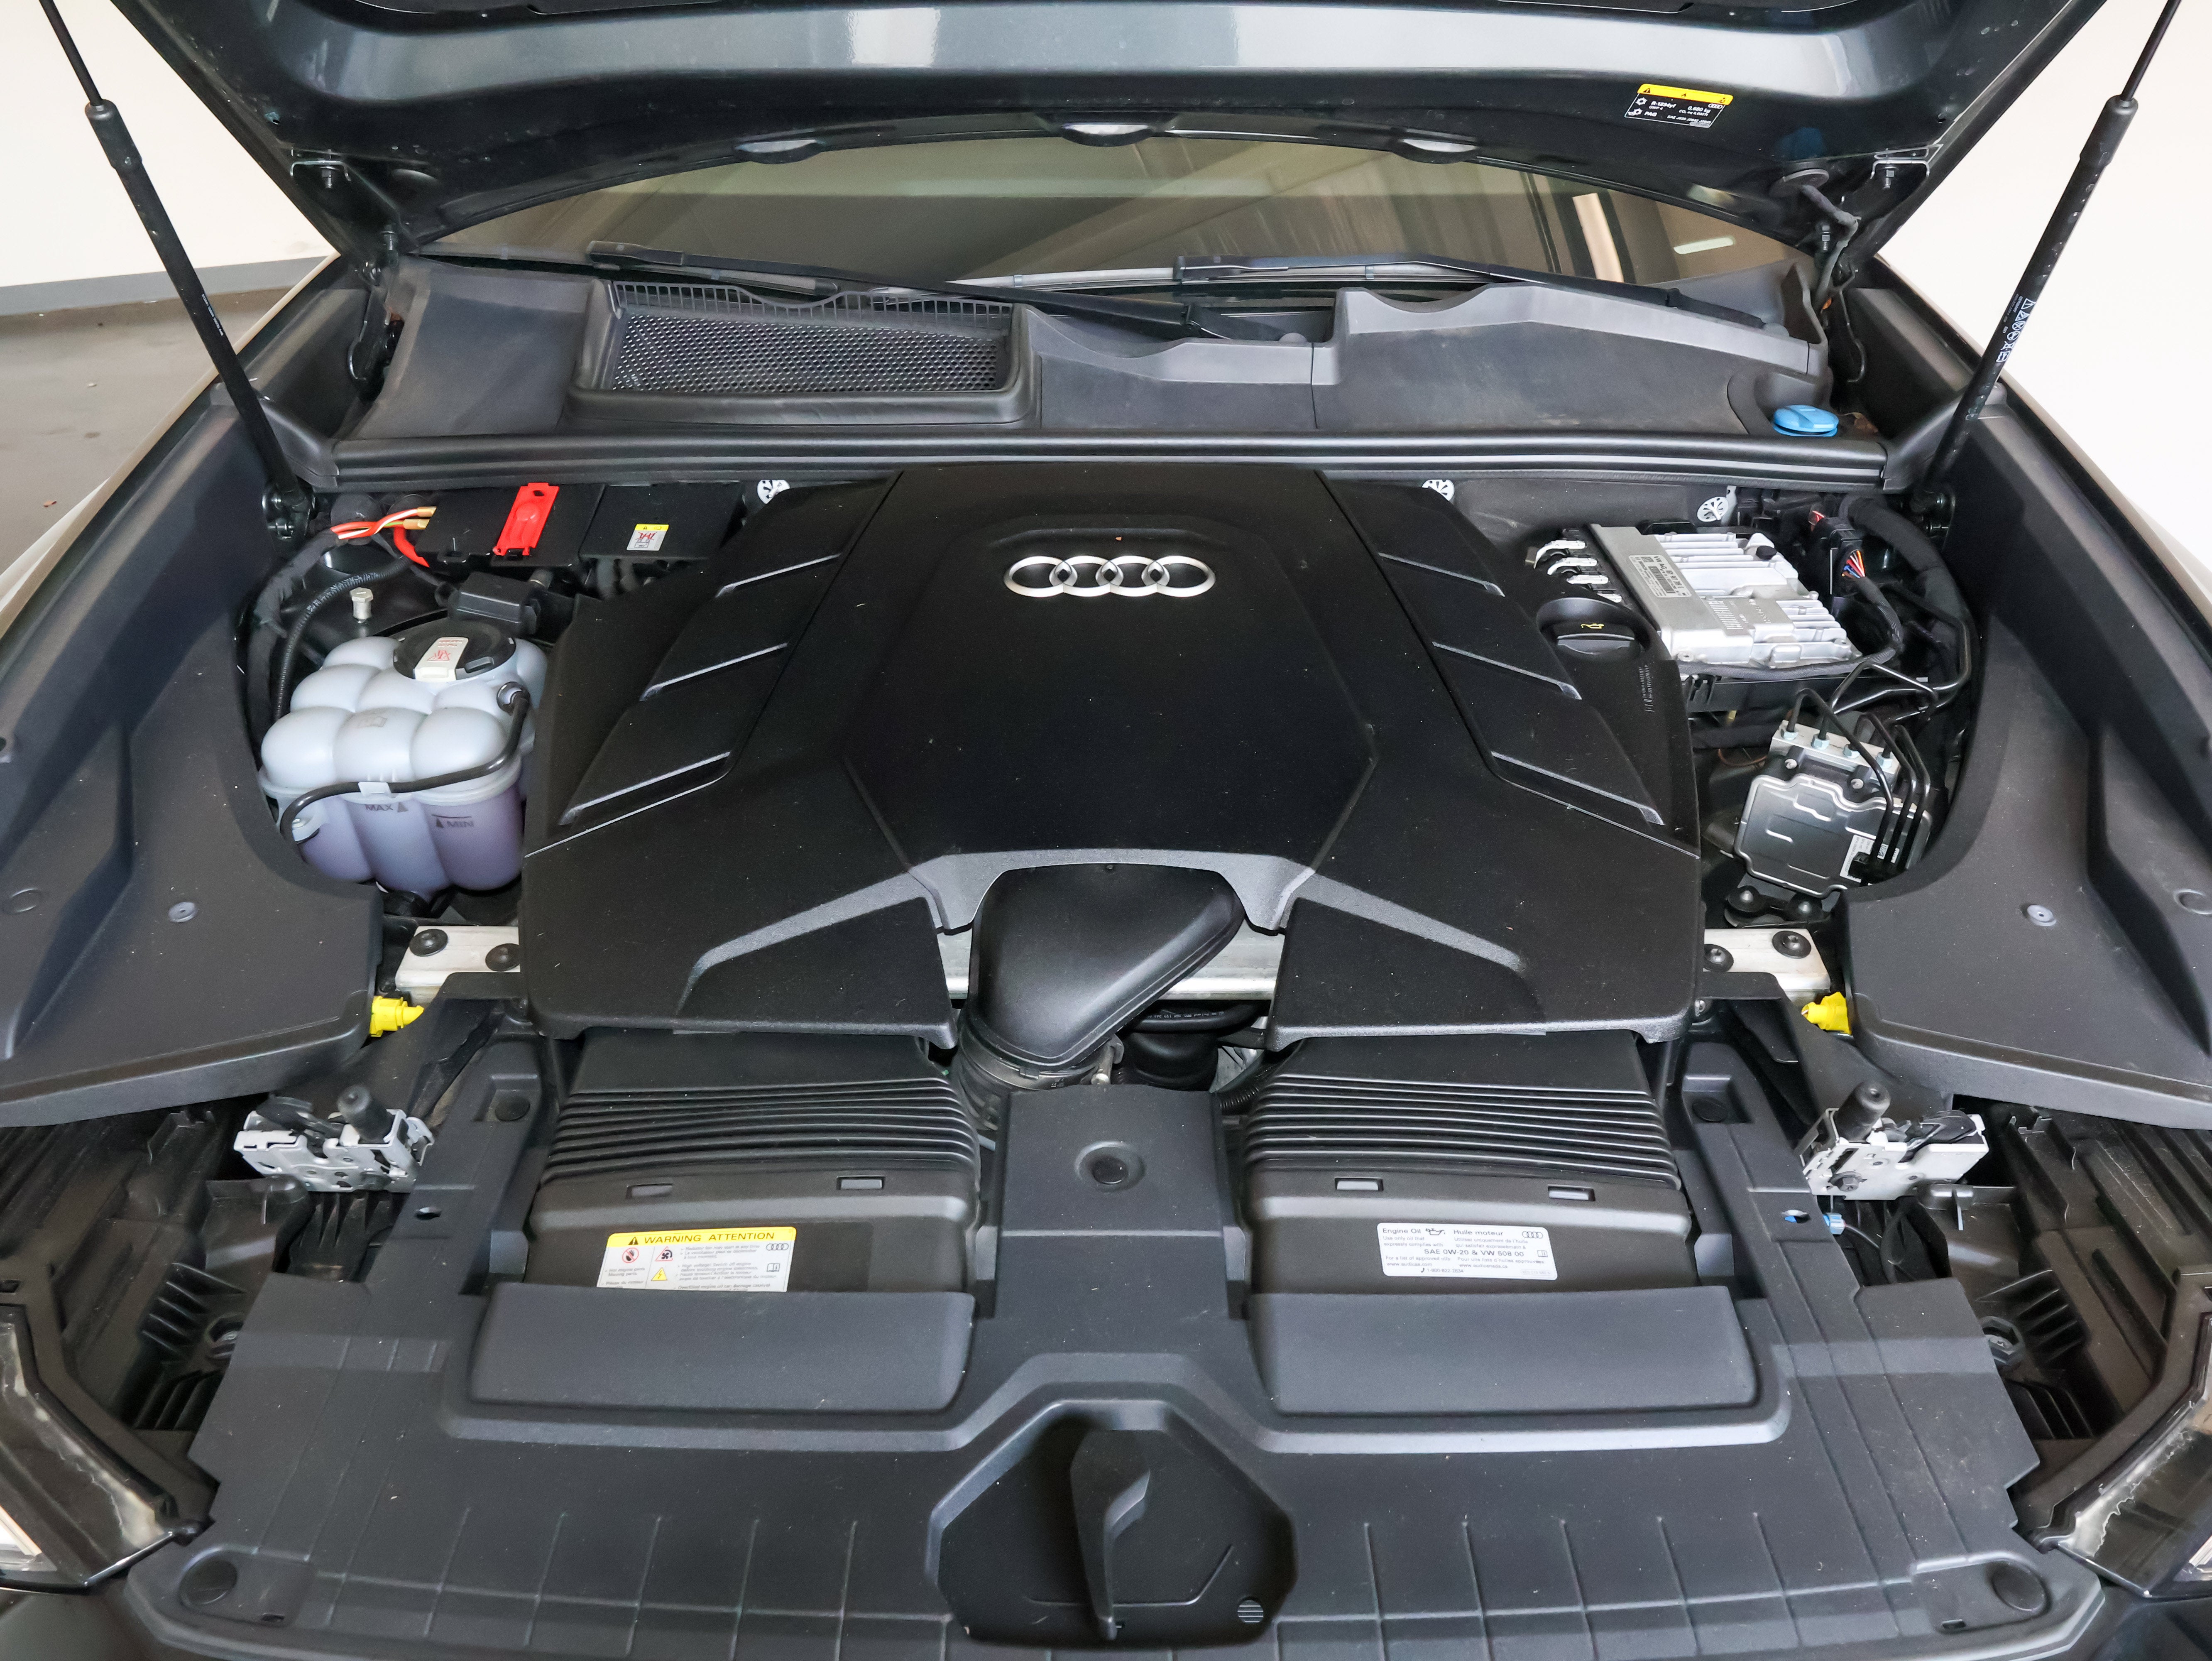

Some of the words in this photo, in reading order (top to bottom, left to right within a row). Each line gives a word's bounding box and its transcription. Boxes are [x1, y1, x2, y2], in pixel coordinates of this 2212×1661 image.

[2013, 296, 2023, 313] GERMANY
[1639, 561, 1648, 571] BOSCH
[644, 1235, 702, 1244] WARNING
[708, 1232, 775, 1241] ATTENTION
